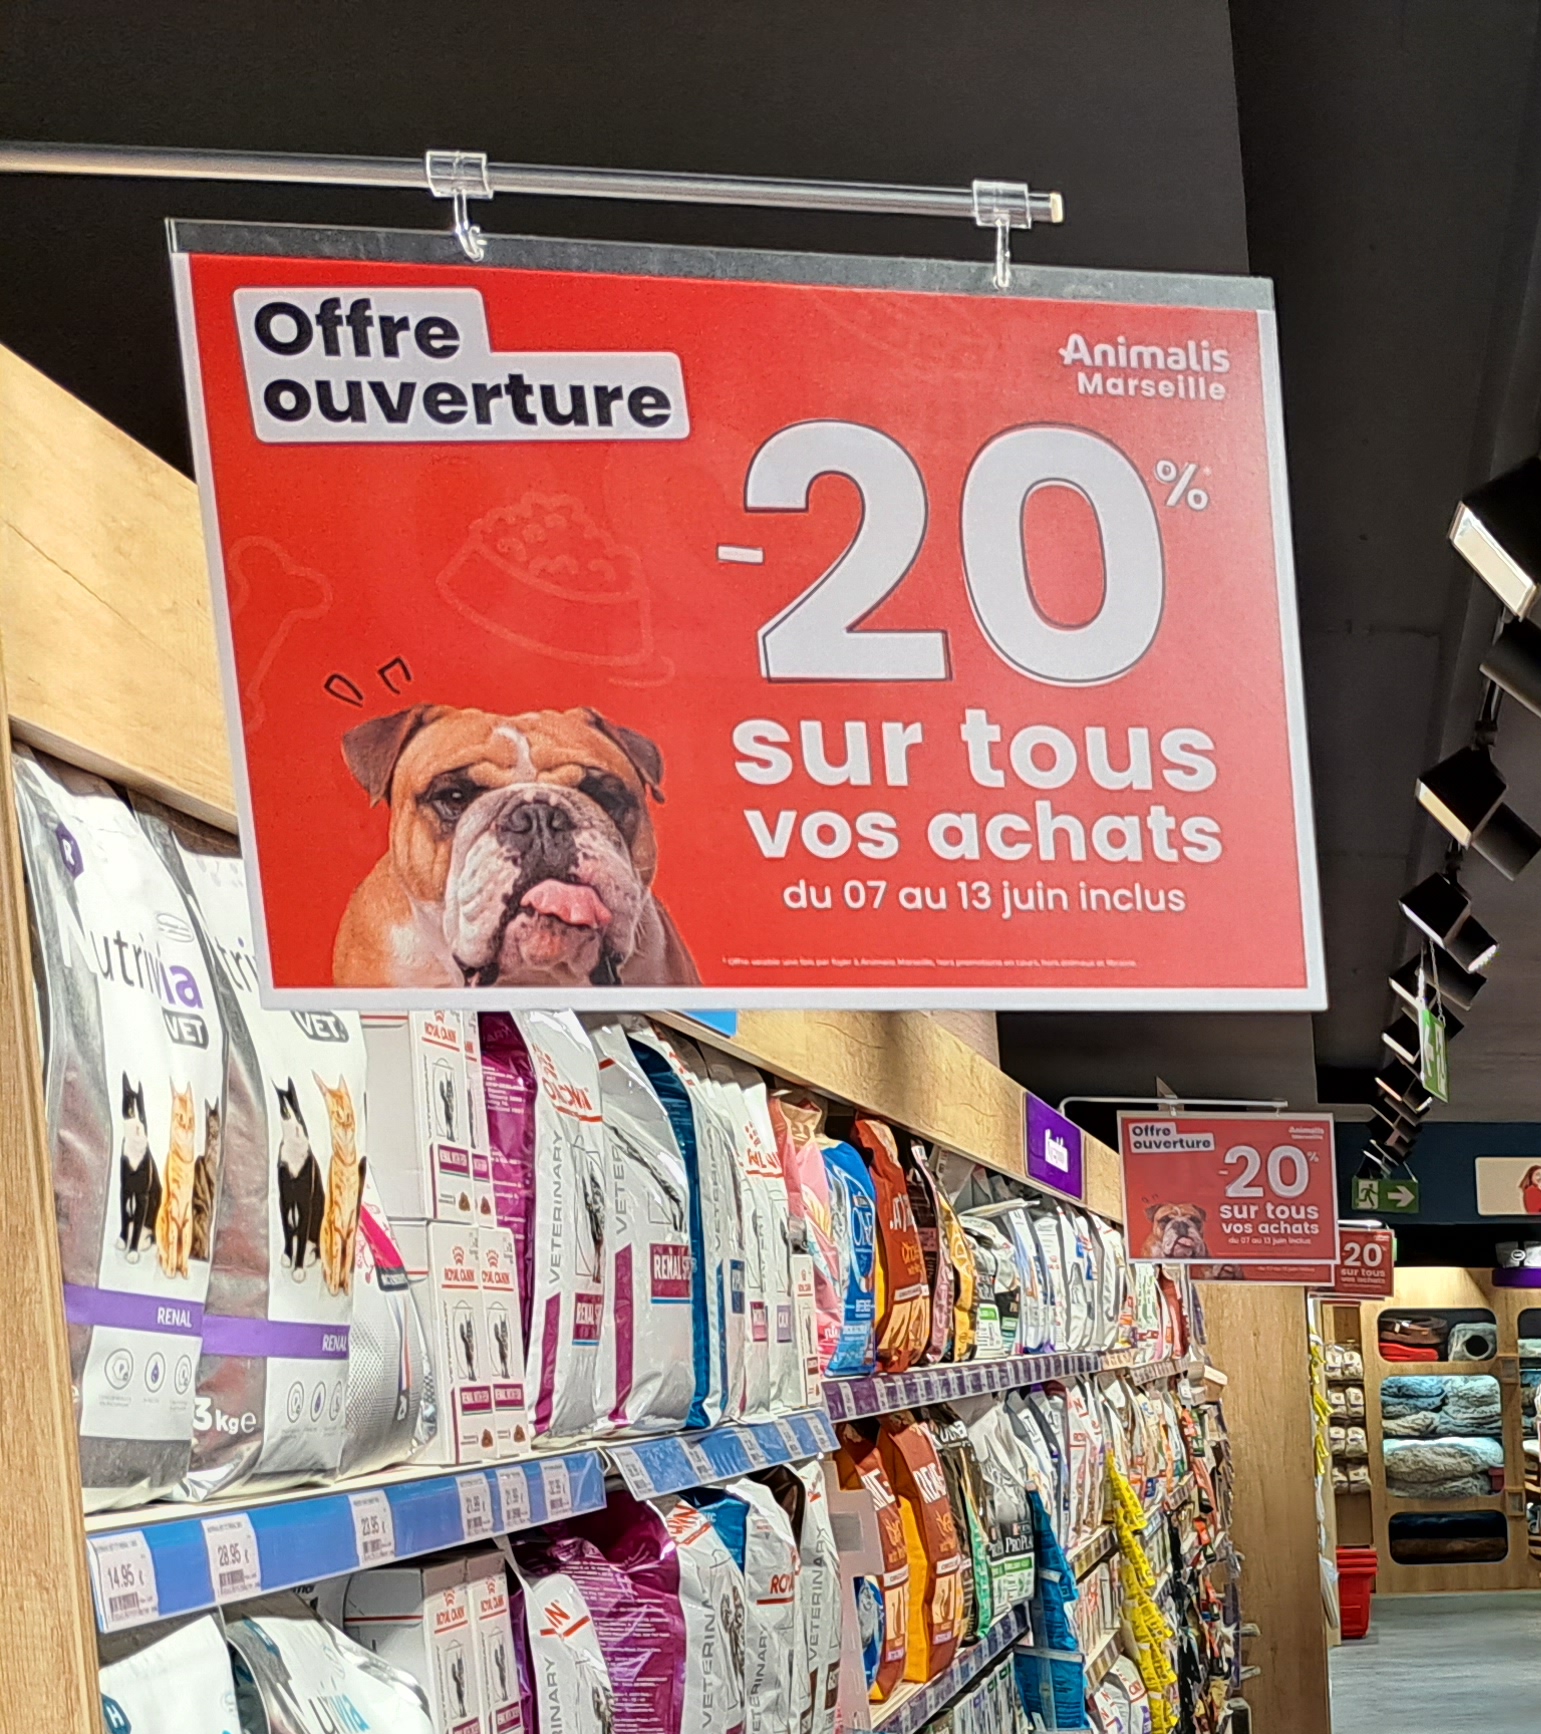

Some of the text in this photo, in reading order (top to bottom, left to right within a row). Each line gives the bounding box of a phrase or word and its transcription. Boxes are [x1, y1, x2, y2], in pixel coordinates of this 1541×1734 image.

[254, 297, 459, 359] Offre
[1059, 333, 1230, 373] Animalis
[1077, 373, 1226, 401] Marseille
[264, 374, 672, 428] ouverture
[731, 708, 1217, 792] sur tous
[743, 800, 1222, 863] vos achats
[782, 879, 1186, 920] du 07 au 13 juin inclus
[1132, 1125, 1171, 1137] Offre
[1133, 1137, 1211, 1150] ouverture
[549, 1129, 564, 1286] VETERINARY
[1220, 1201, 1319, 1220] sur tous
[1222, 1220, 1319, 1235] vos achats
[157, 1307, 192, 1328] RENAL
[361, 1517, 381, 1538] 23.95
[217, 1543, 242, 1566] 28.95
[107, 1567, 135, 1591] 14.95
